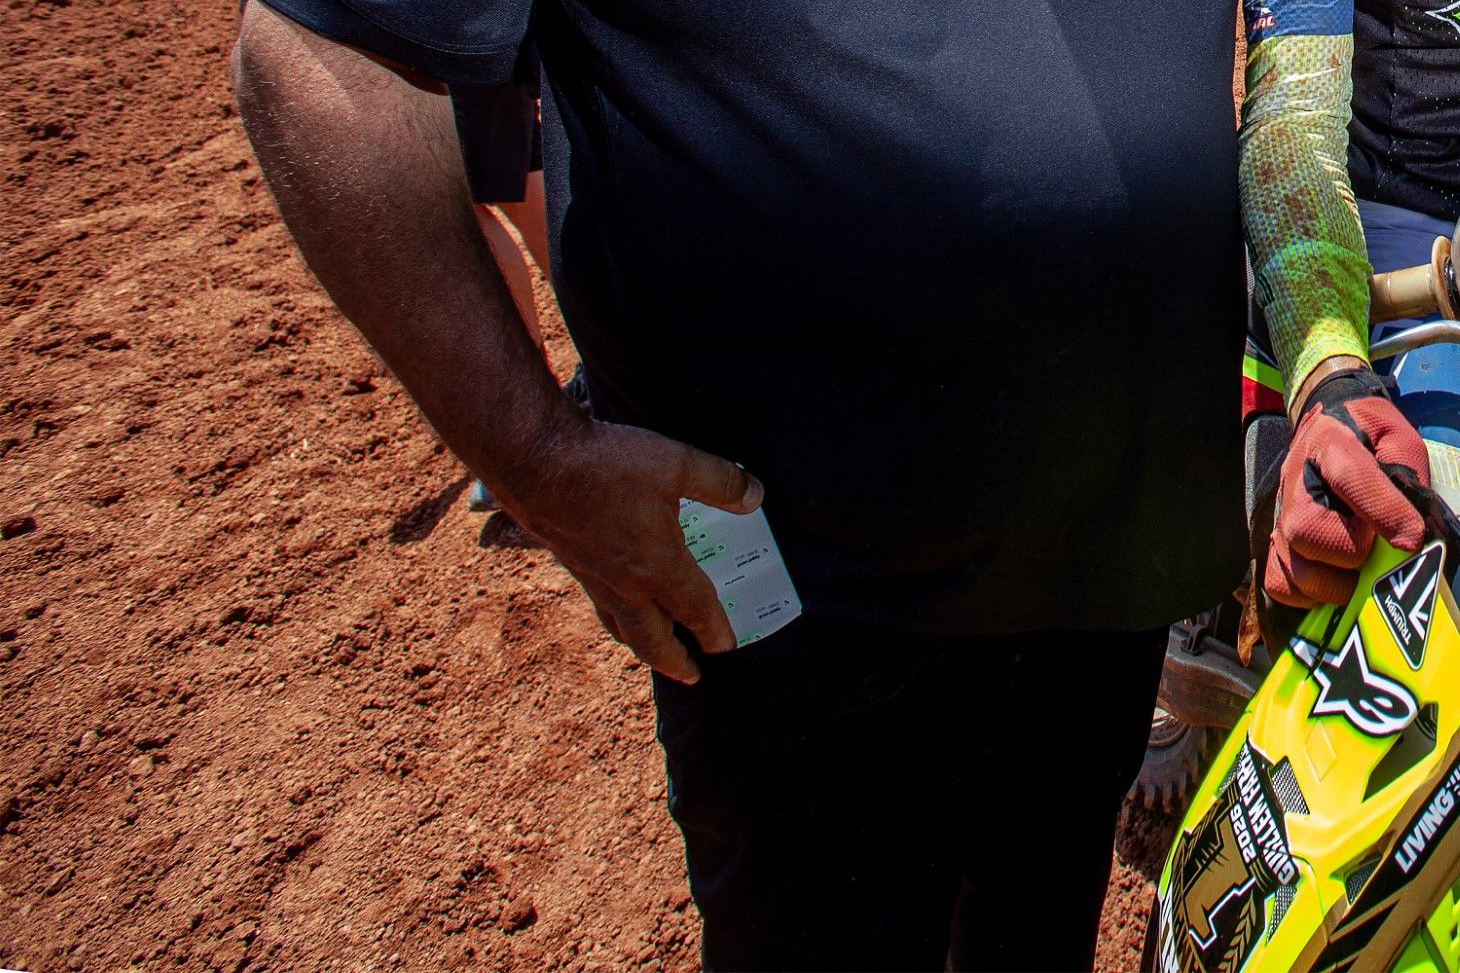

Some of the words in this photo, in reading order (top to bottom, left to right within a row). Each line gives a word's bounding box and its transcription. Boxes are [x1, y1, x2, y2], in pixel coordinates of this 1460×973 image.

[1384, 594, 1412, 646] TRIUMPH
[1230, 800, 1258, 865] 2026
[1247, 793, 1295, 886] GUILLEM
[1394, 787, 1455, 875] LIVING
